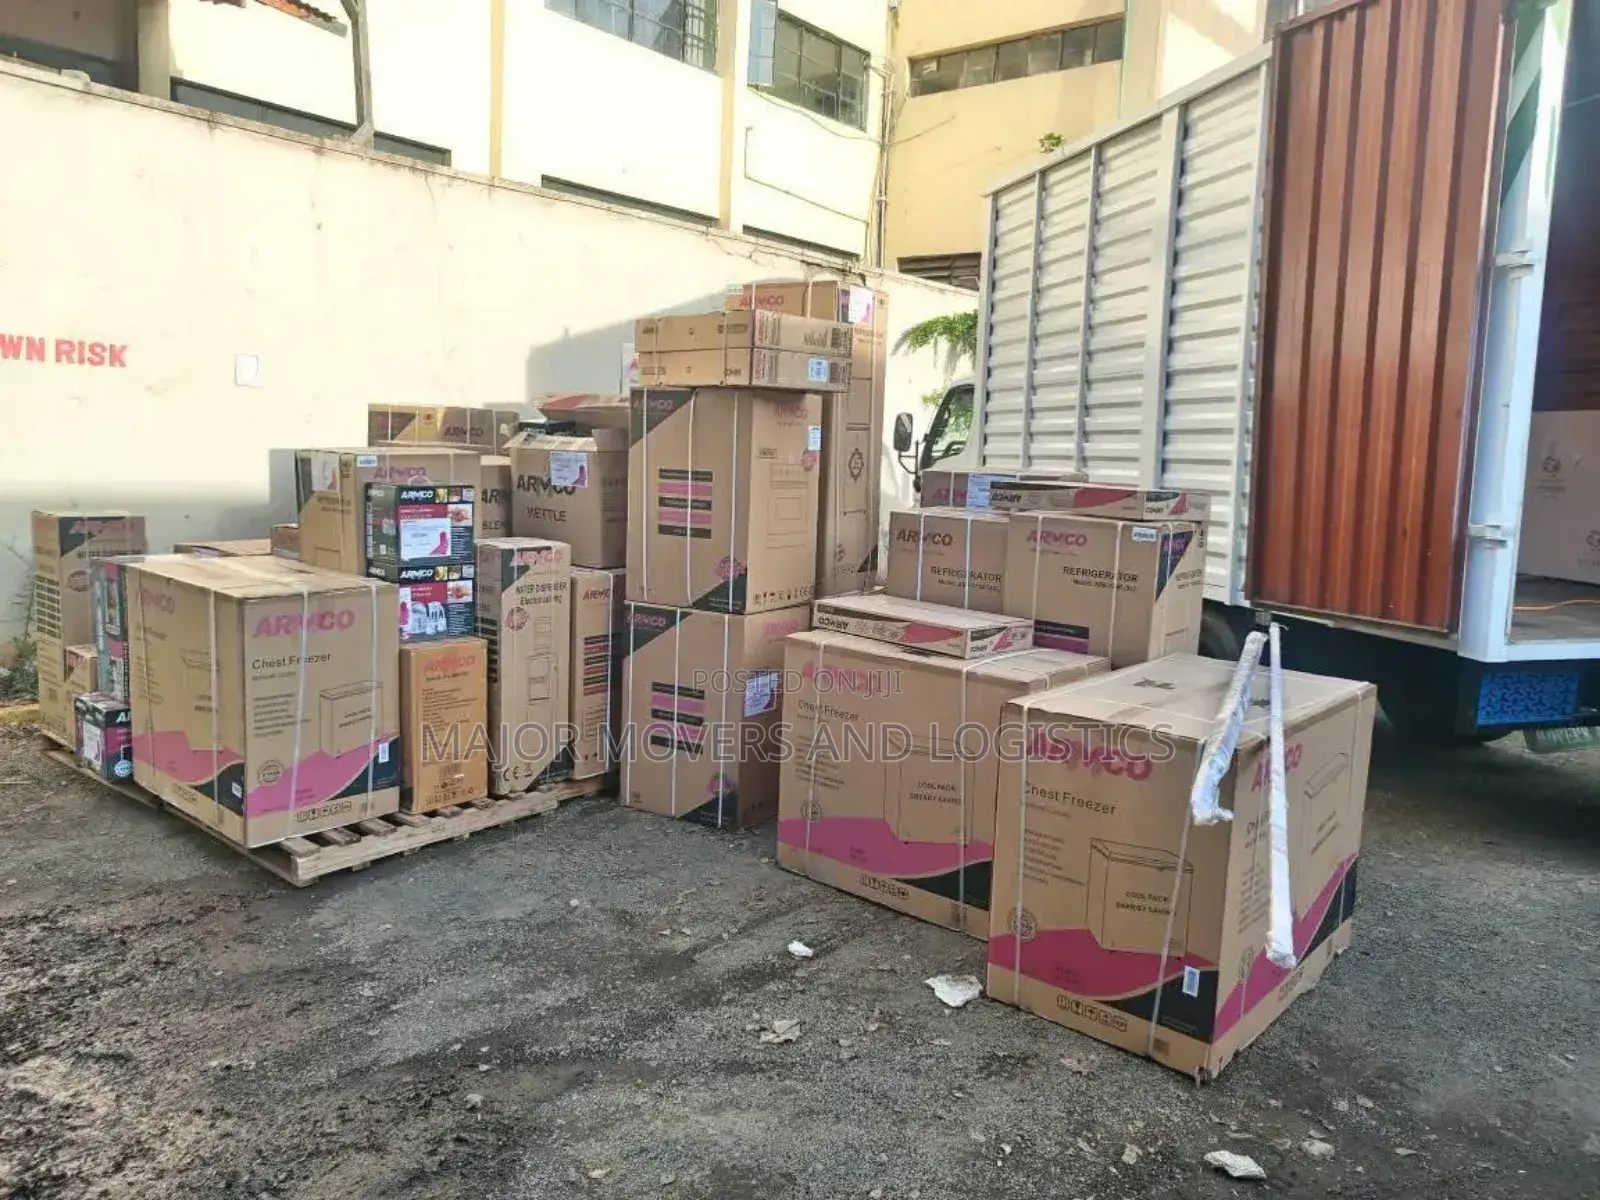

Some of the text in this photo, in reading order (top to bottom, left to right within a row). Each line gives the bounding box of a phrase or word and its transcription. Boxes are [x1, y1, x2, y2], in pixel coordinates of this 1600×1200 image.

[55, 338, 128, 368] RISK
[400, 489, 434, 501] ARMCO
[526, 506, 567, 522] KETTLE
[896, 527, 954, 547] ARMCO
[1026, 529, 1088, 547] ARMCO
[400, 568, 434, 580] ARMCO
[1063, 565, 1139, 583] REFRIGERATOR
[252, 608, 356, 638] ARMCO
[626, 612, 667, 627] ARMCO
[252, 653, 332, 671] Chest Freezer
[824, 704, 860, 721] Freezer
[1024, 780, 1059, 802] Chest
[1062, 791, 1118, 816] Freezer
